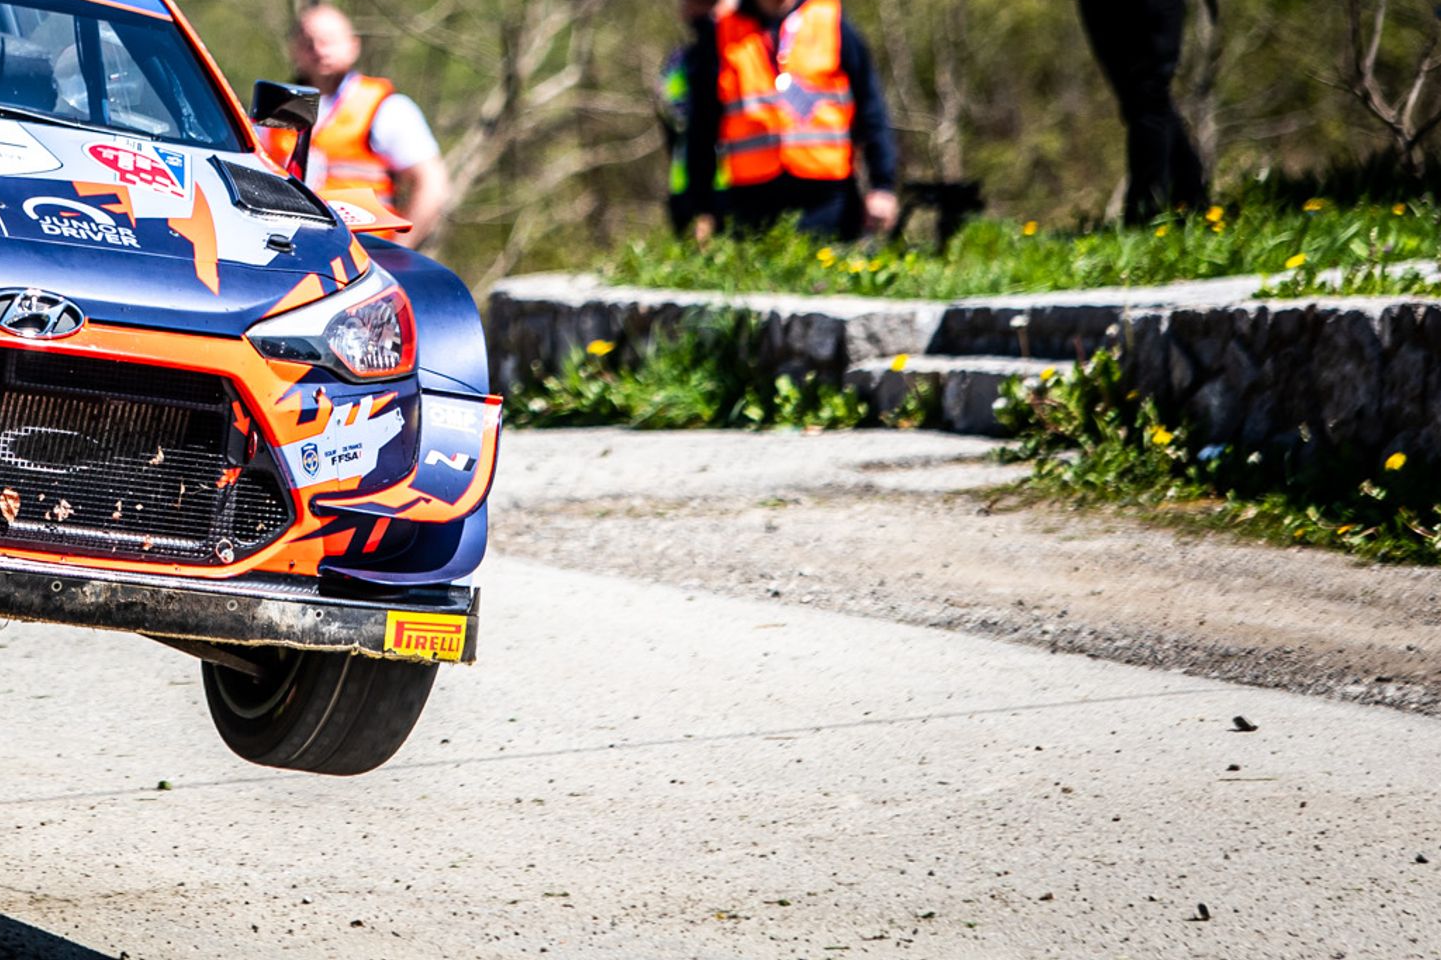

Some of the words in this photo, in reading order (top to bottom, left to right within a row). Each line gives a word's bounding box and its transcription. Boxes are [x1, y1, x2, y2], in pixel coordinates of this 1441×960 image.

[39, 215, 136, 238] JUNIOR
[41, 224, 141, 249] DRIVER
[393, 620, 462, 652] PIRELLI
